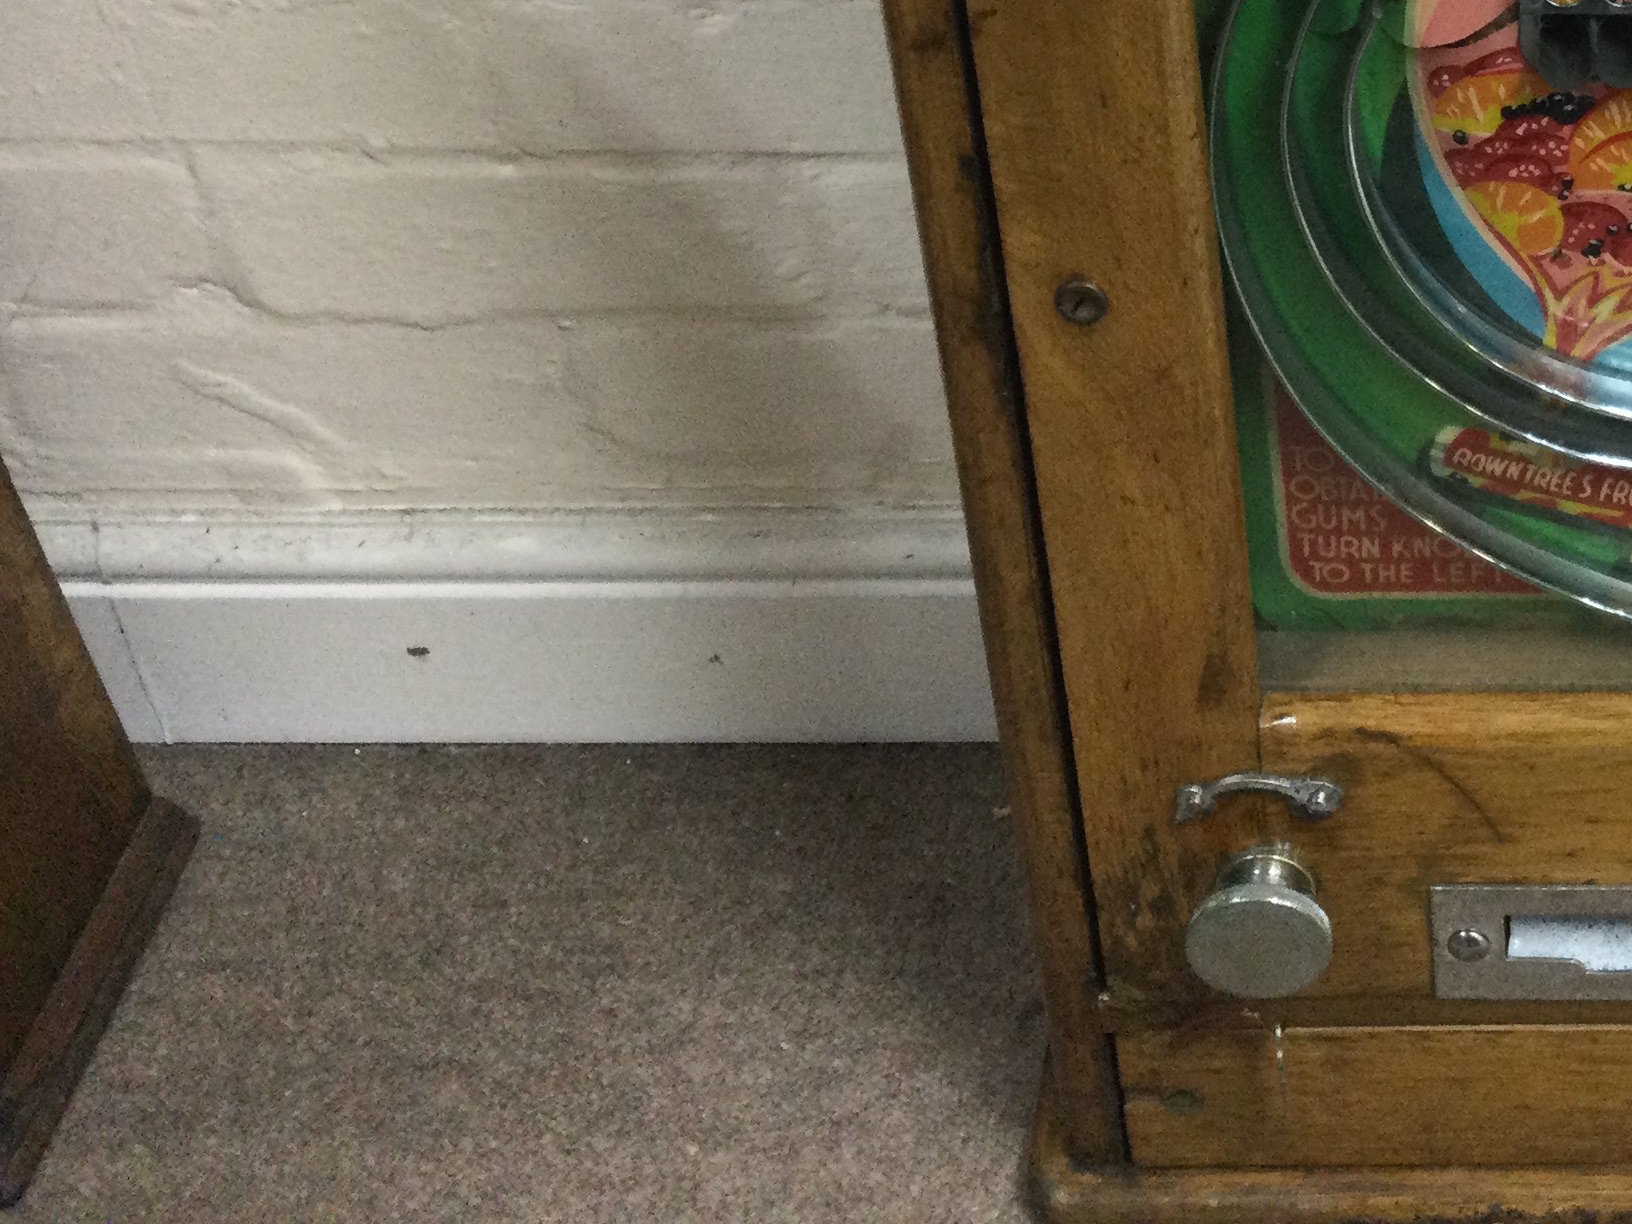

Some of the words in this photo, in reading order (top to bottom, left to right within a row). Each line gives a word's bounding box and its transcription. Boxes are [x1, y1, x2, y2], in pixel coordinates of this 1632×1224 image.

[1288, 445, 1335, 473] TO
[1288, 474, 1382, 502] OBTA
[1290, 502, 1389, 533] GUMS
[1298, 533, 1382, 559] TURN
[1391, 534, 1472, 560] KNO
[1308, 561, 1351, 584] TO
[1360, 562, 1415, 584] THE
